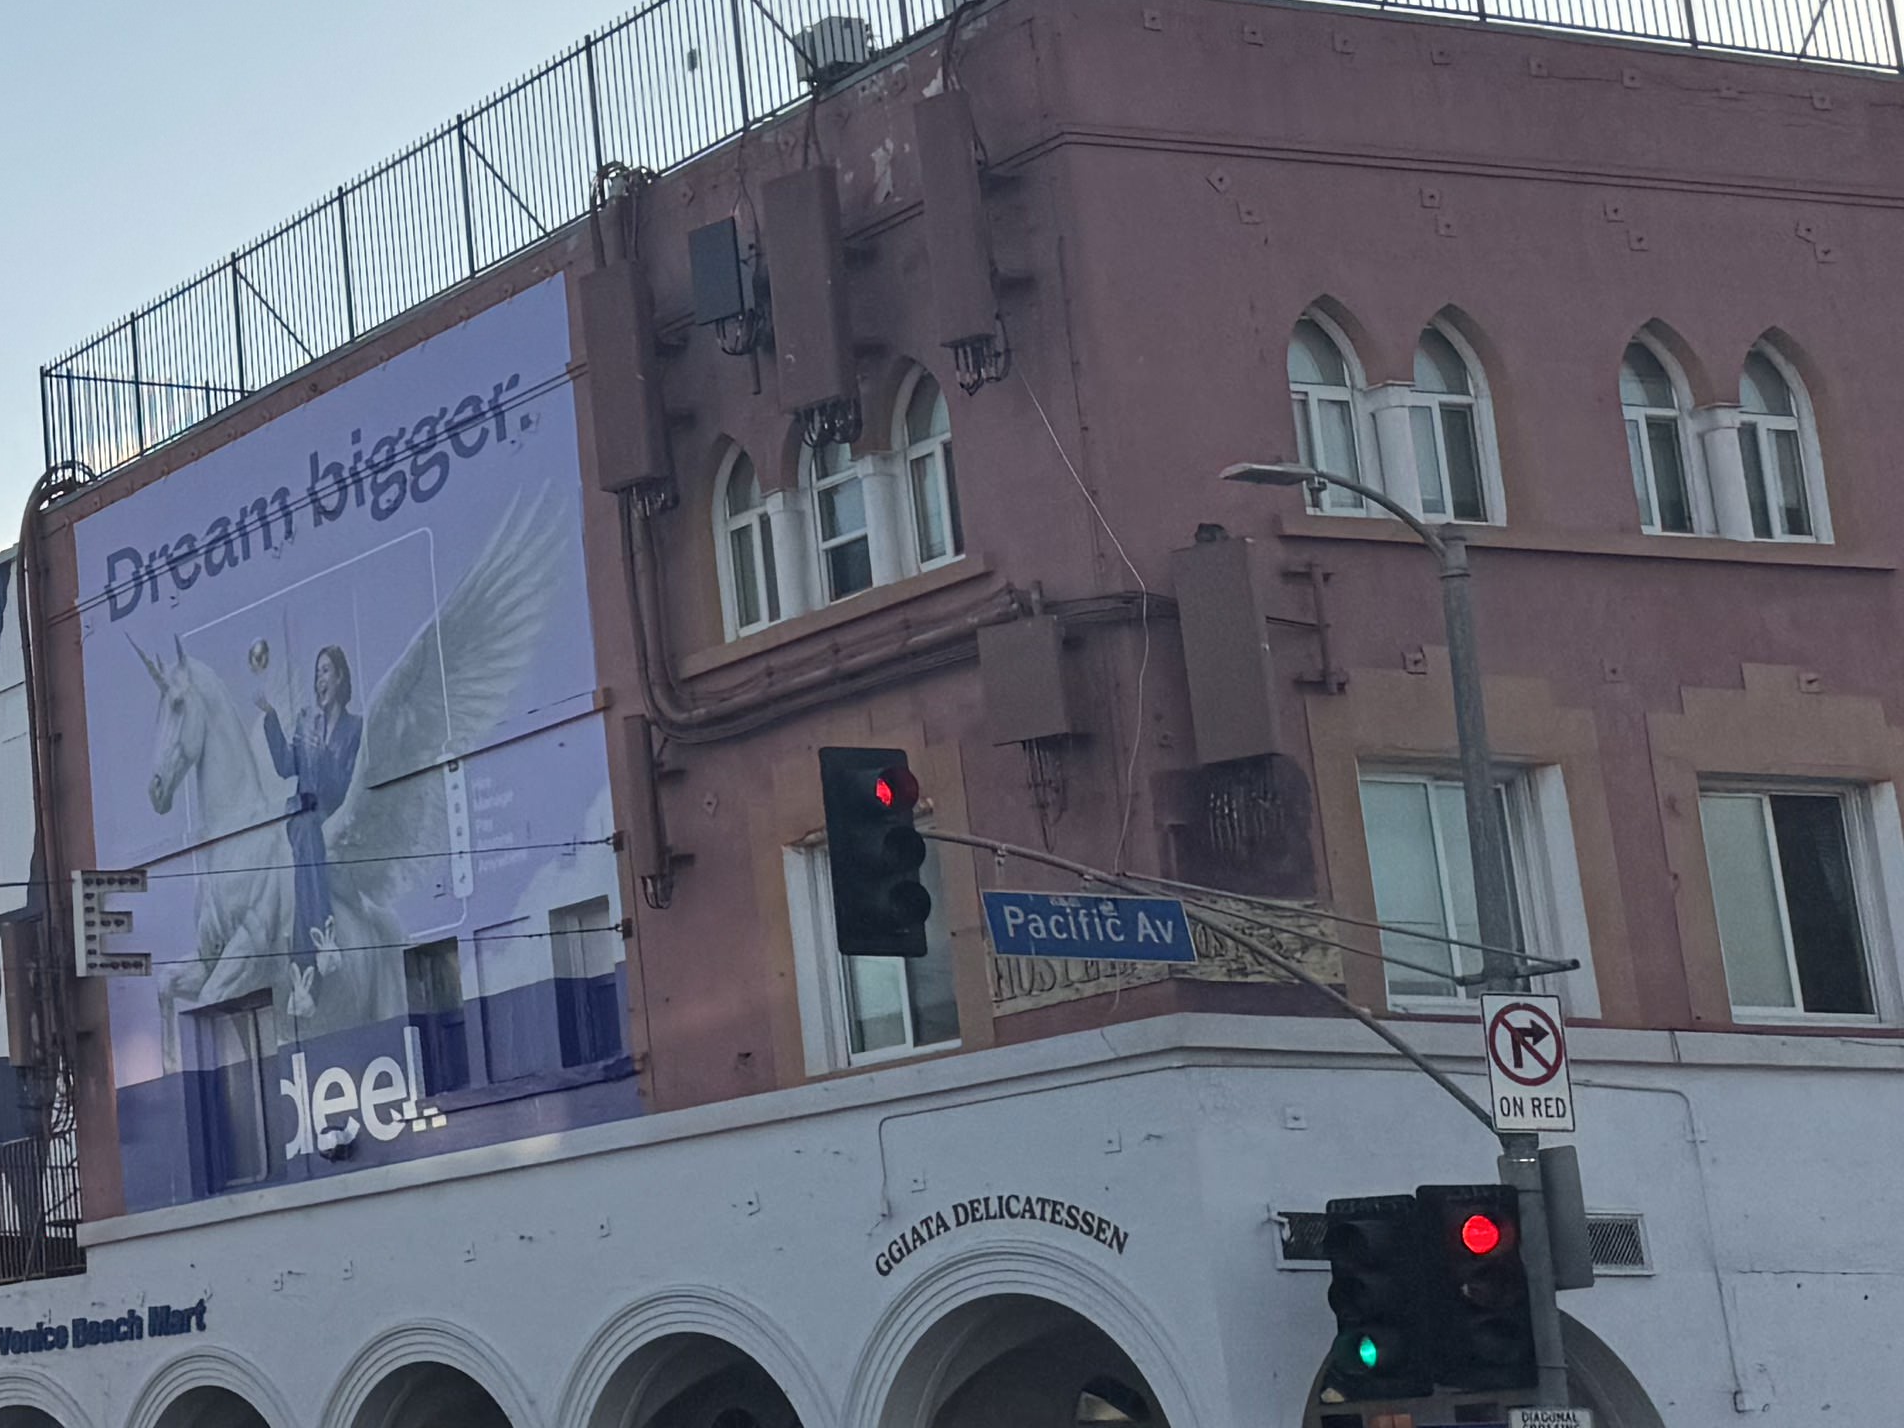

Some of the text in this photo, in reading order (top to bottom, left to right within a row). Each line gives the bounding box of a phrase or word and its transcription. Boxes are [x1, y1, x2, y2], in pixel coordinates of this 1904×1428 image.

[103, 374, 537, 622] Dream bigger.
[1003, 905, 1126, 943] Pacific
[1137, 914, 1174, 944] Av
[1499, 1096, 1567, 1118] ON RED
[875, 1194, 1129, 1277] GGIATA DELICATESSEN
[72, 1309, 144, 1348] Beach
[148, 1298, 207, 1337] Mart
